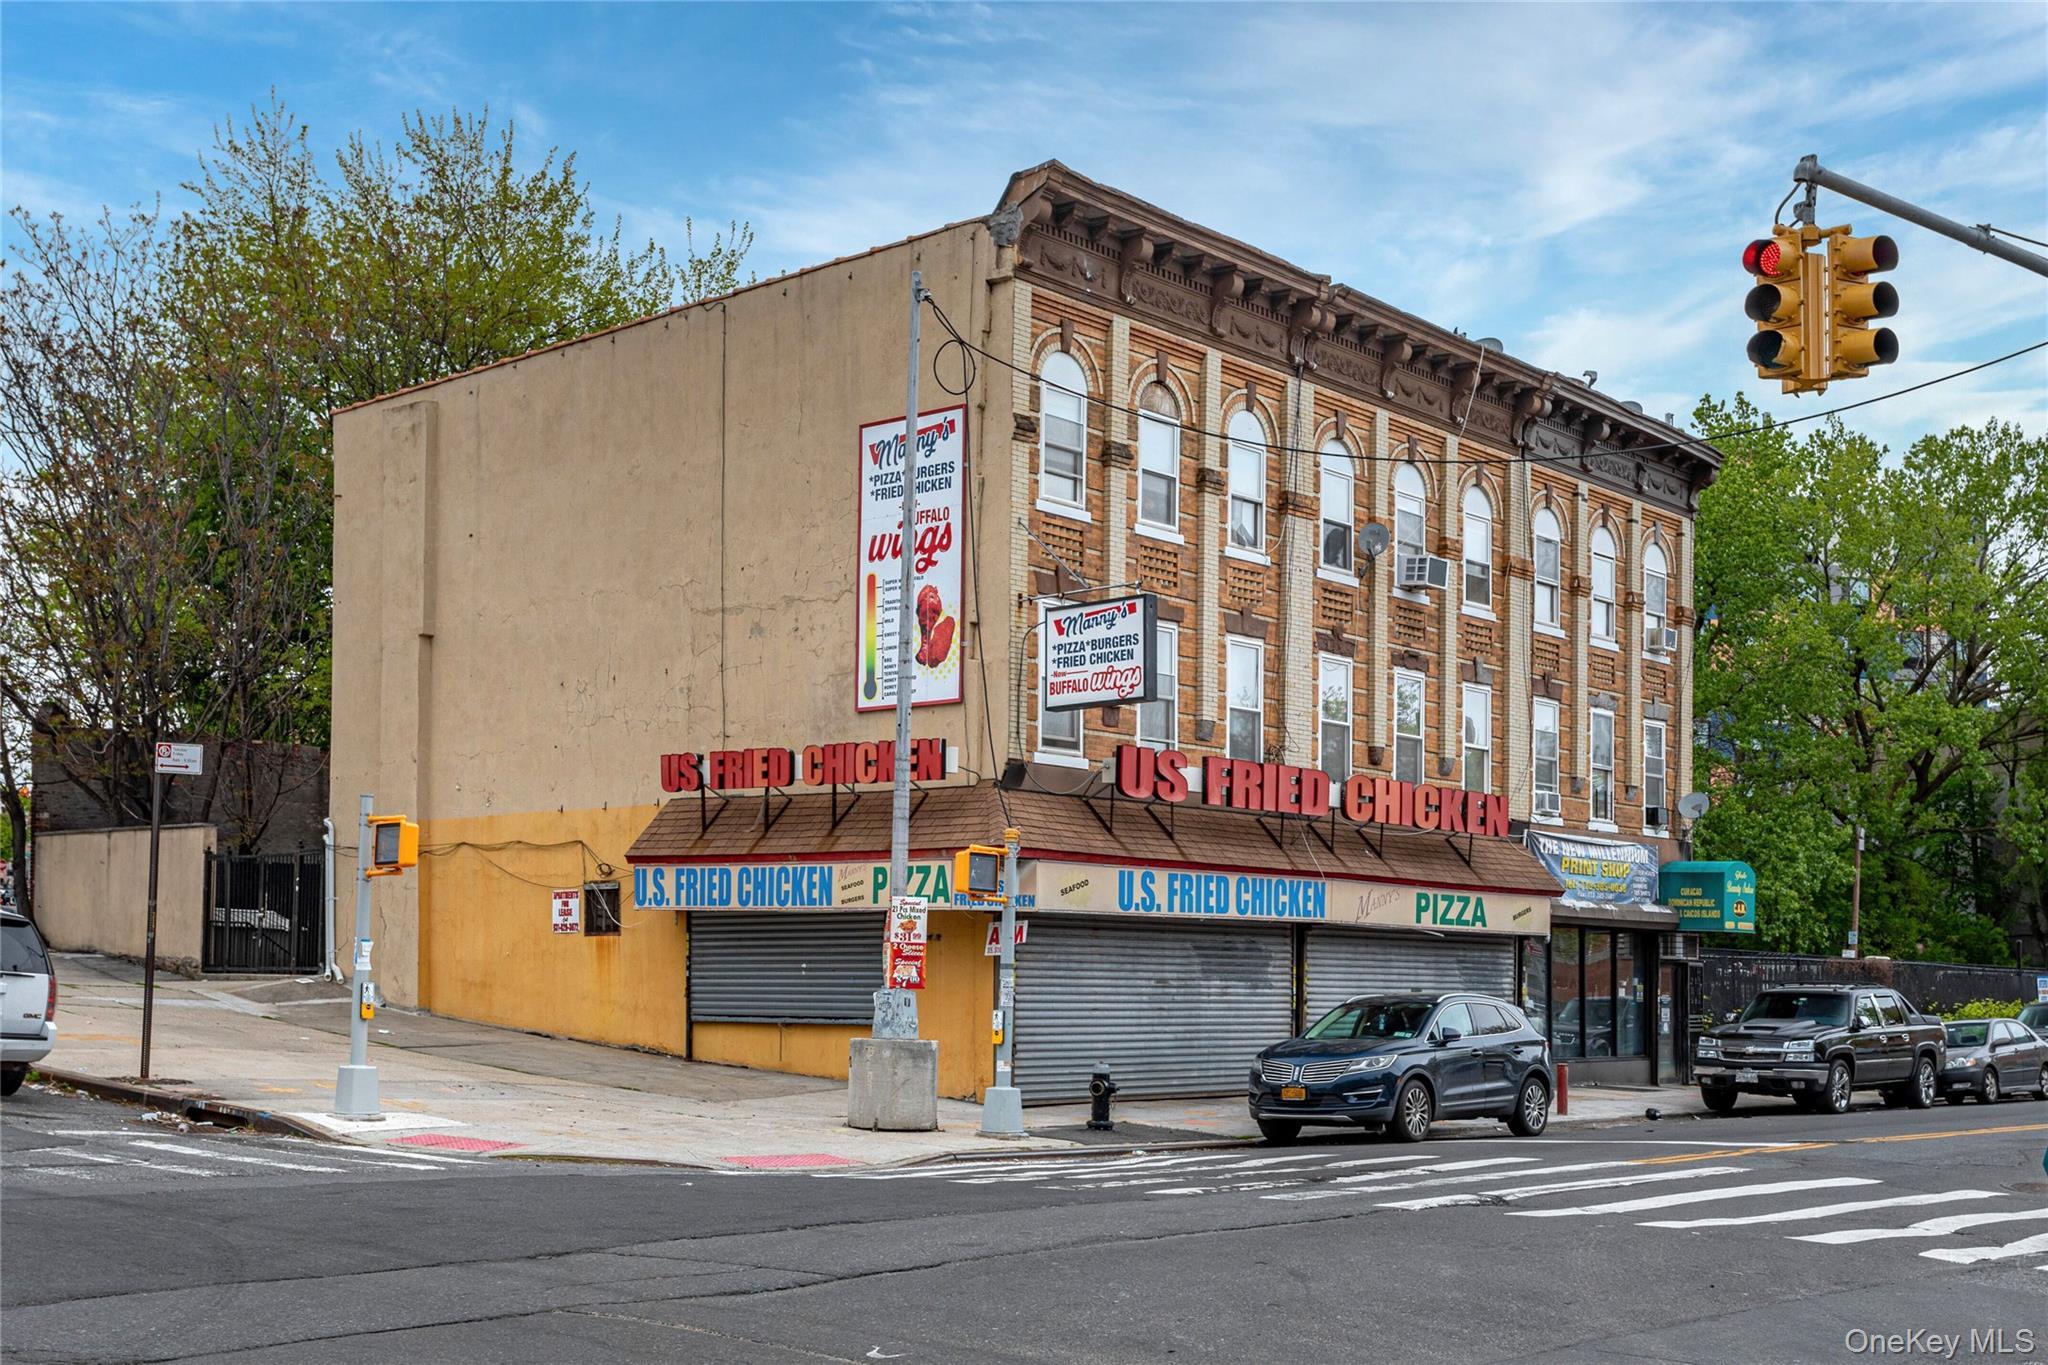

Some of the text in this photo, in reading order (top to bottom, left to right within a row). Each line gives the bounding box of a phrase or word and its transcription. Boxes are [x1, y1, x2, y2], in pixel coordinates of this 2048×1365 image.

[876, 416, 949, 470] Many's
[915, 460, 955, 480] URGERS
[915, 475, 952, 495] HICKEN
[914, 506, 950, 526] UFFALO
[868, 520, 953, 575] wigs
[1063, 601, 1127, 637] Manny's
[1089, 648, 1134, 665] CHICKEN
[1049, 665, 1142, 698] BUFFALO wings
[660, 752, 701, 792] US
[710, 747, 795, 790] FRIED
[1116, 744, 1509, 837] US FRIED CHICKEN
[1538, 837, 1560, 855] THE
[1562, 842, 1586, 858] NEW
[872, 865, 950, 904] PZZA
[1560, 856, 1630, 879] PRINT SHOP
[634, 866, 833, 907] U.S. FRIED CHICKEN
[841, 879, 864, 891] SEAFOOD
[1060, 878, 1089, 896] SEAFOOD
[1117, 870, 1326, 919] U.S. FRIED CHICKEN
[1415, 892, 1487, 928] PIZZA
